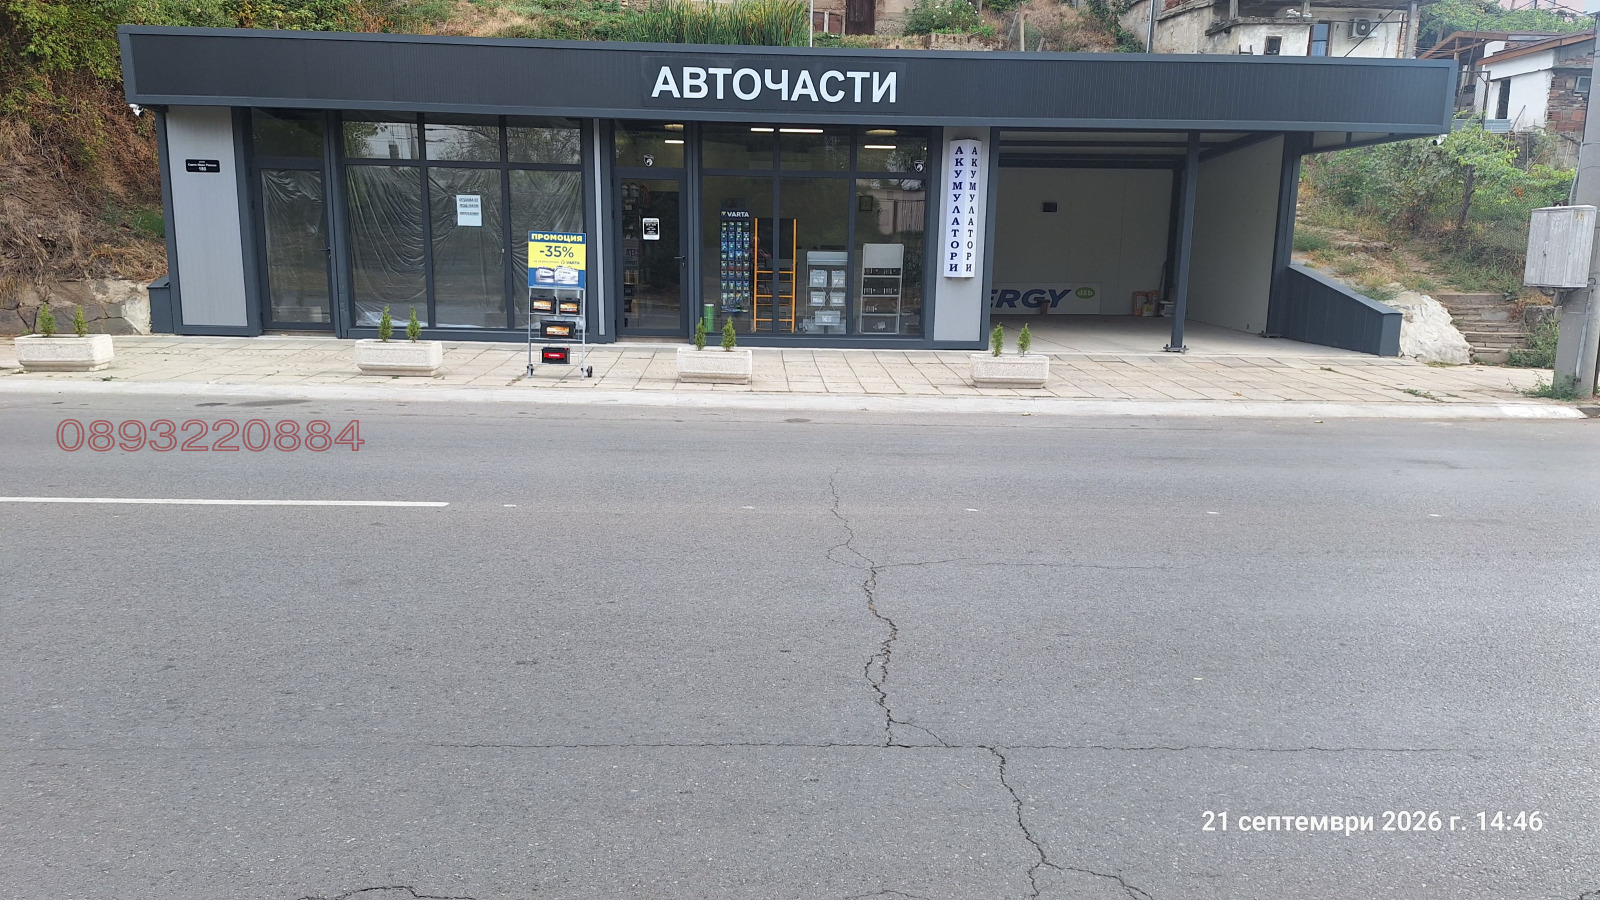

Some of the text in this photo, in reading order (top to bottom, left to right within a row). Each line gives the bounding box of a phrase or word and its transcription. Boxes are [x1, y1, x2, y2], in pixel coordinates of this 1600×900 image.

[652, 66, 897, 103] АВТОЧАСТИ
[949, 146, 964, 272] АКУМУЛАТОРИ
[965, 146, 978, 272] АКУМУЛАТОРИ
[531, 233, 583, 242] ПРОМОЦИЯ
[539, 245, 574, 258] -35%
